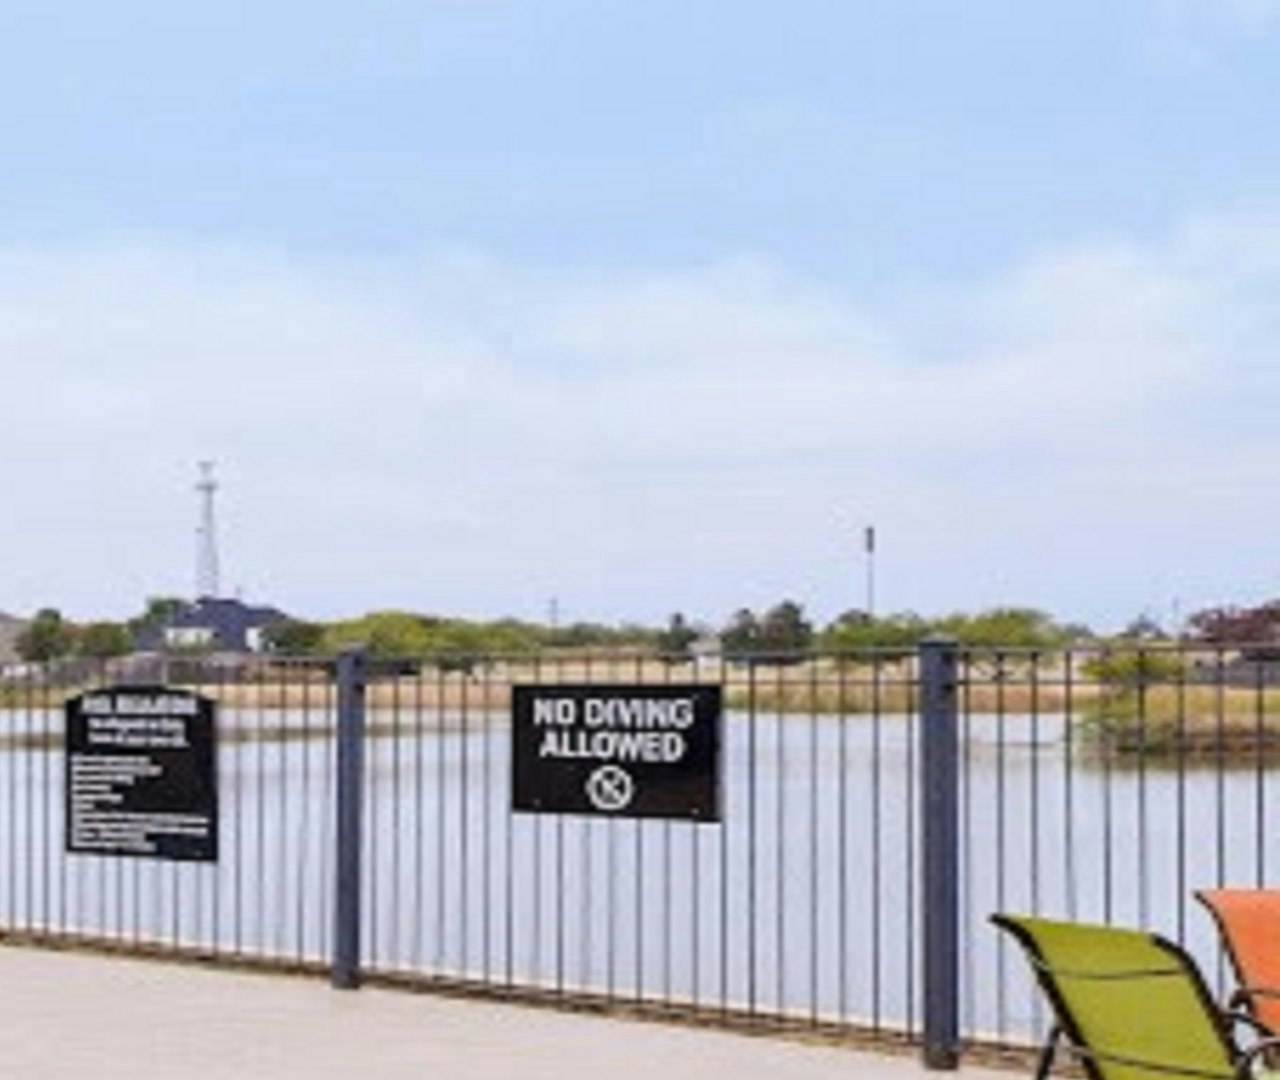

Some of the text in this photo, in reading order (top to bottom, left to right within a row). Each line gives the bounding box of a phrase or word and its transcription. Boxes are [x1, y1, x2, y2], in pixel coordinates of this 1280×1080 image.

[533, 698, 694, 730] NO DIVING
[539, 730, 686, 763] ALLOWED
